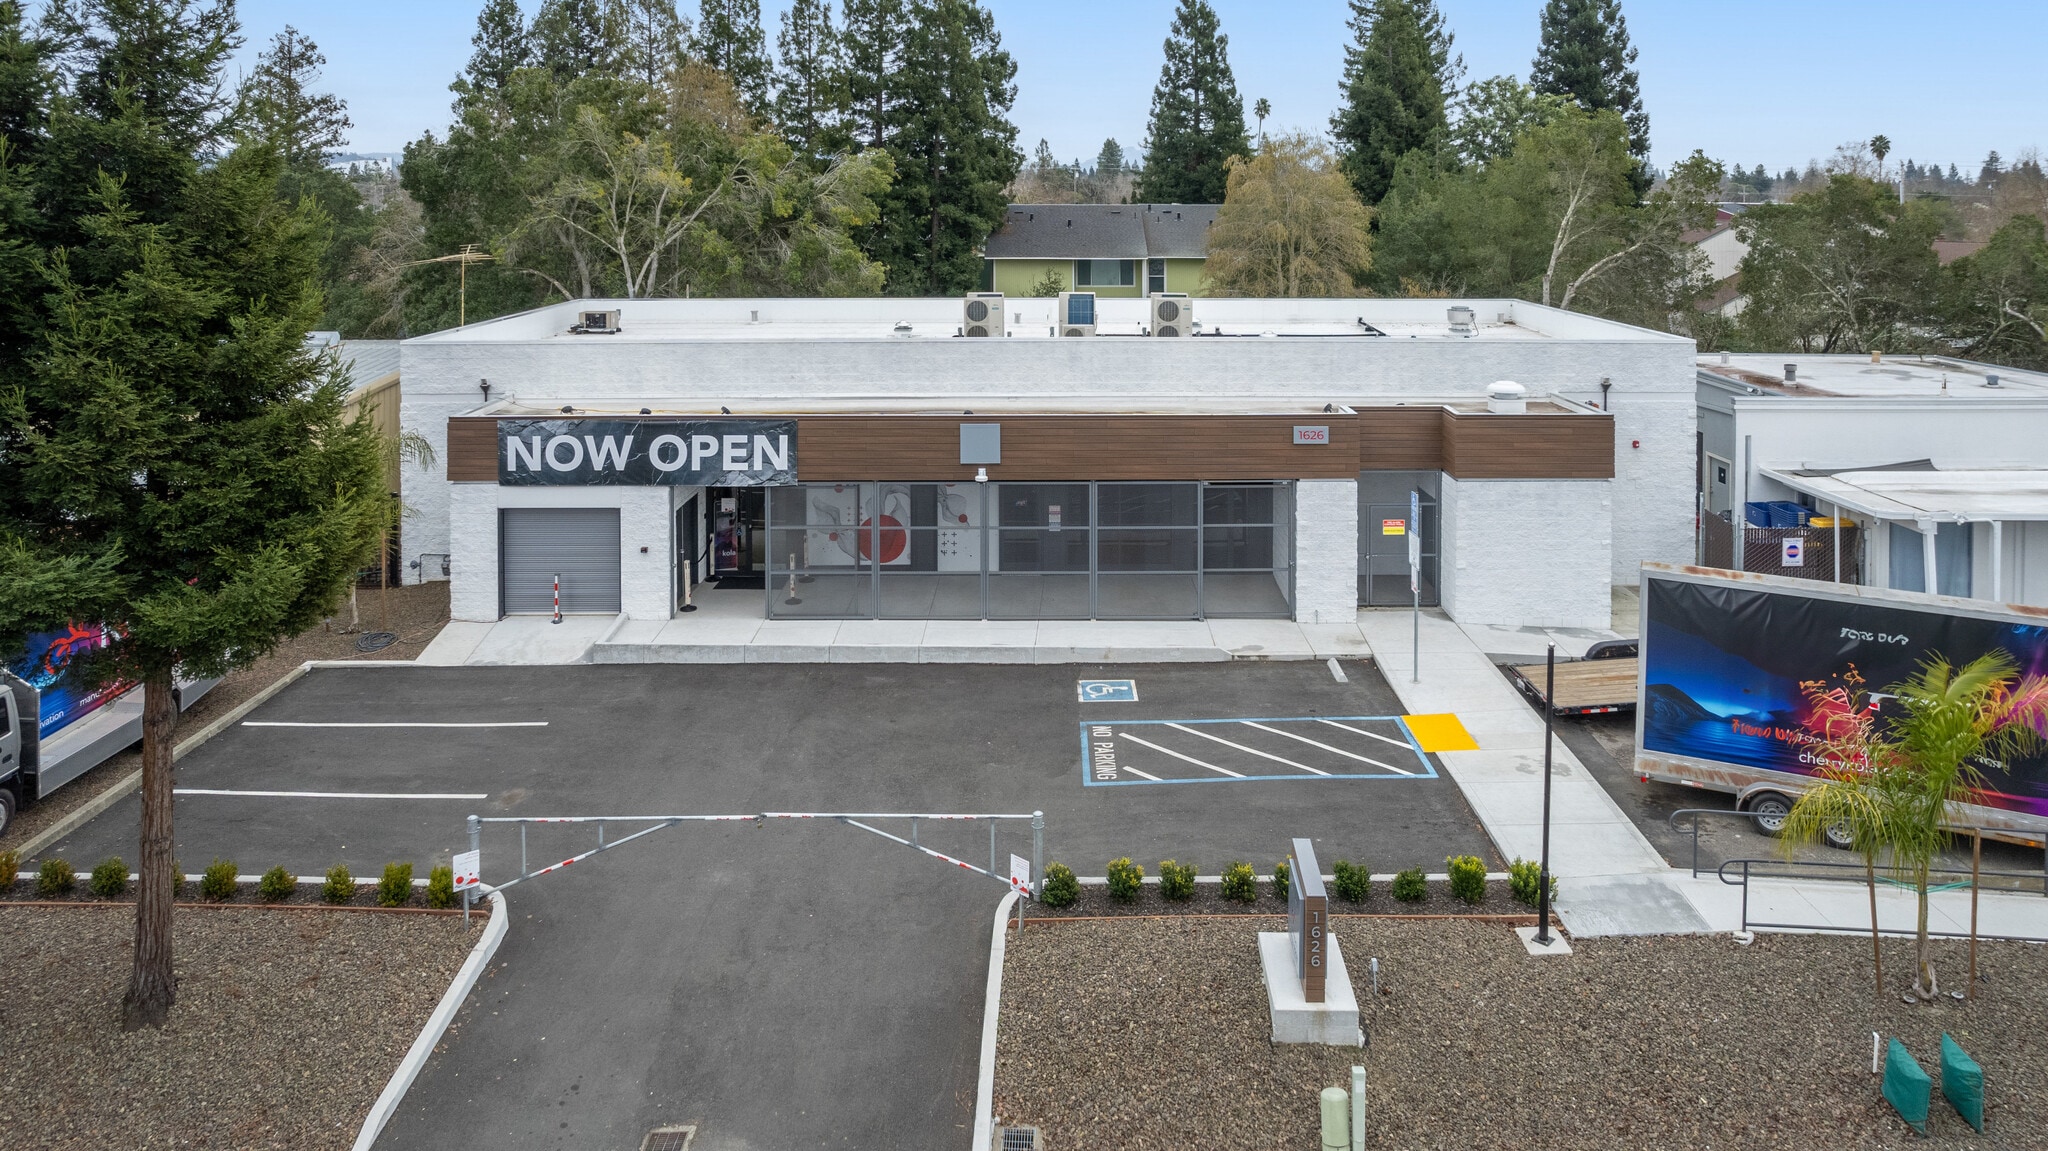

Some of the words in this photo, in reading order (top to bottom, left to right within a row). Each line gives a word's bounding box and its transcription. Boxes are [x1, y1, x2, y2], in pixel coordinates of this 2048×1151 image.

[1298, 430, 1325, 440] 1626
[506, 435, 634, 472] NOW
[649, 434, 788, 472] OPEN
[722, 549, 736, 557] kola
[1092, 726, 1112, 737] NO
[1093, 742, 1117, 780] PARKING
[1311, 911, 1321, 967] 1626
